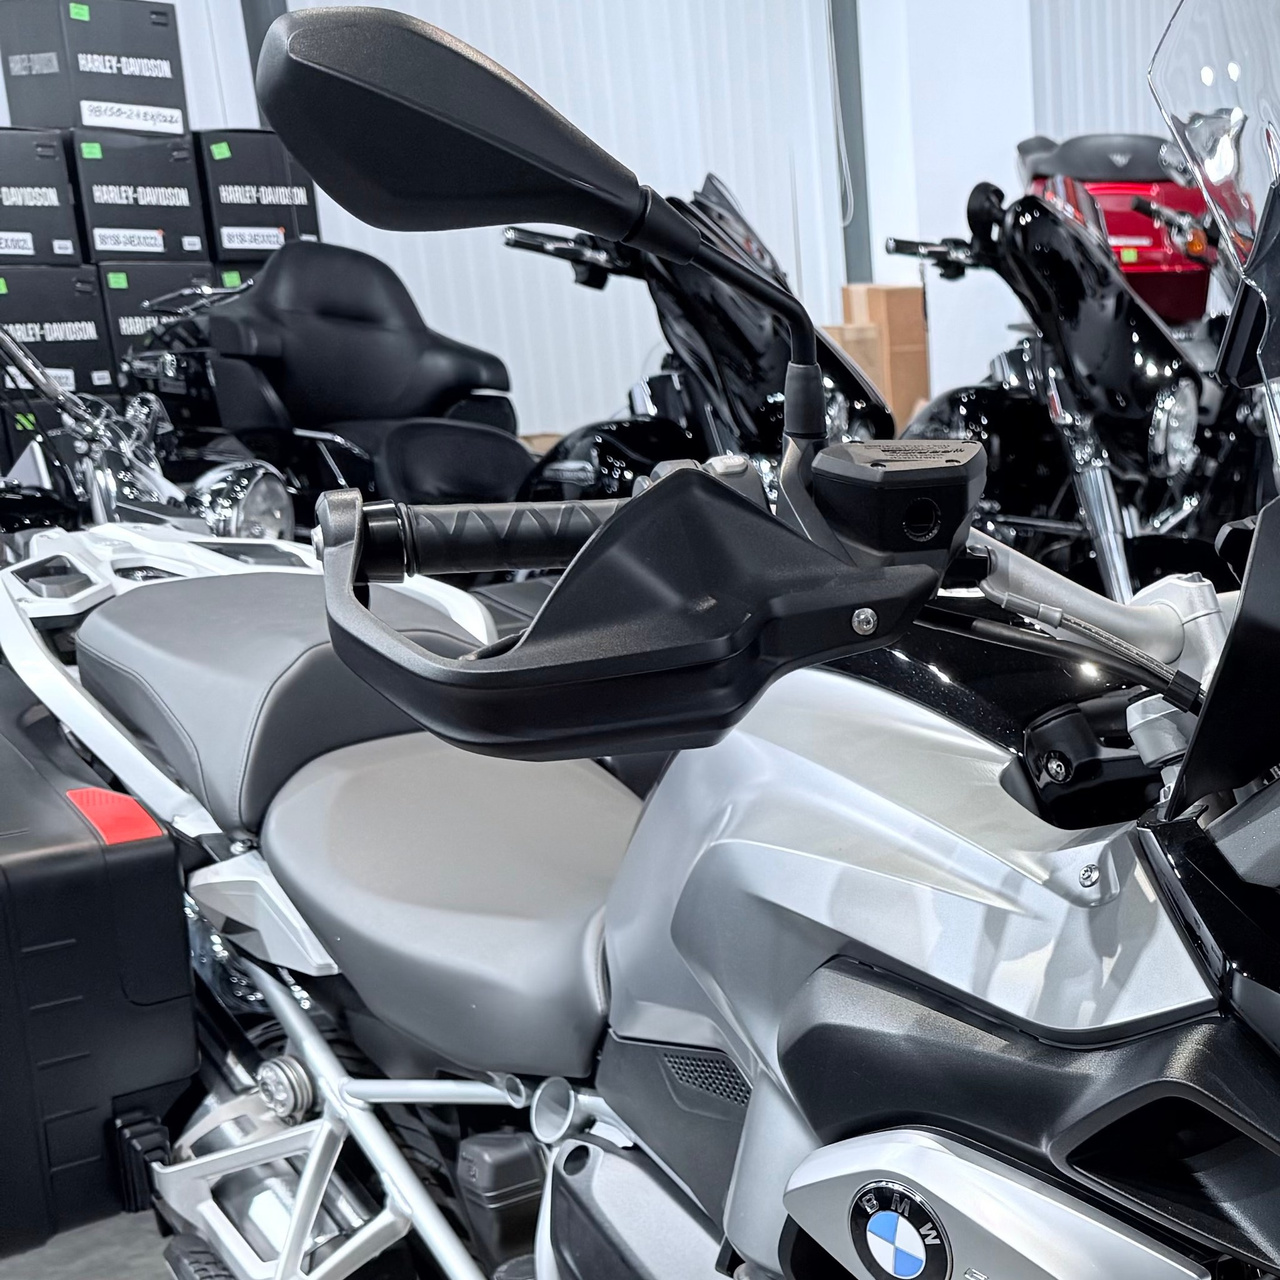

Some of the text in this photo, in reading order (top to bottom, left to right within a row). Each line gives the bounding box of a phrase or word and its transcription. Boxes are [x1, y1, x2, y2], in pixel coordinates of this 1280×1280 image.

[77, 53, 173, 78] HARLEY-DAVIDSON
[92, 184, 190, 207] HARLEY-DAVIDSON
[219, 184, 308, 206] HARLEY-DAVIDSON
[2, 320, 98, 342] ARLEY-DAVIDSON
[857, 1193, 941, 1246] BMW
